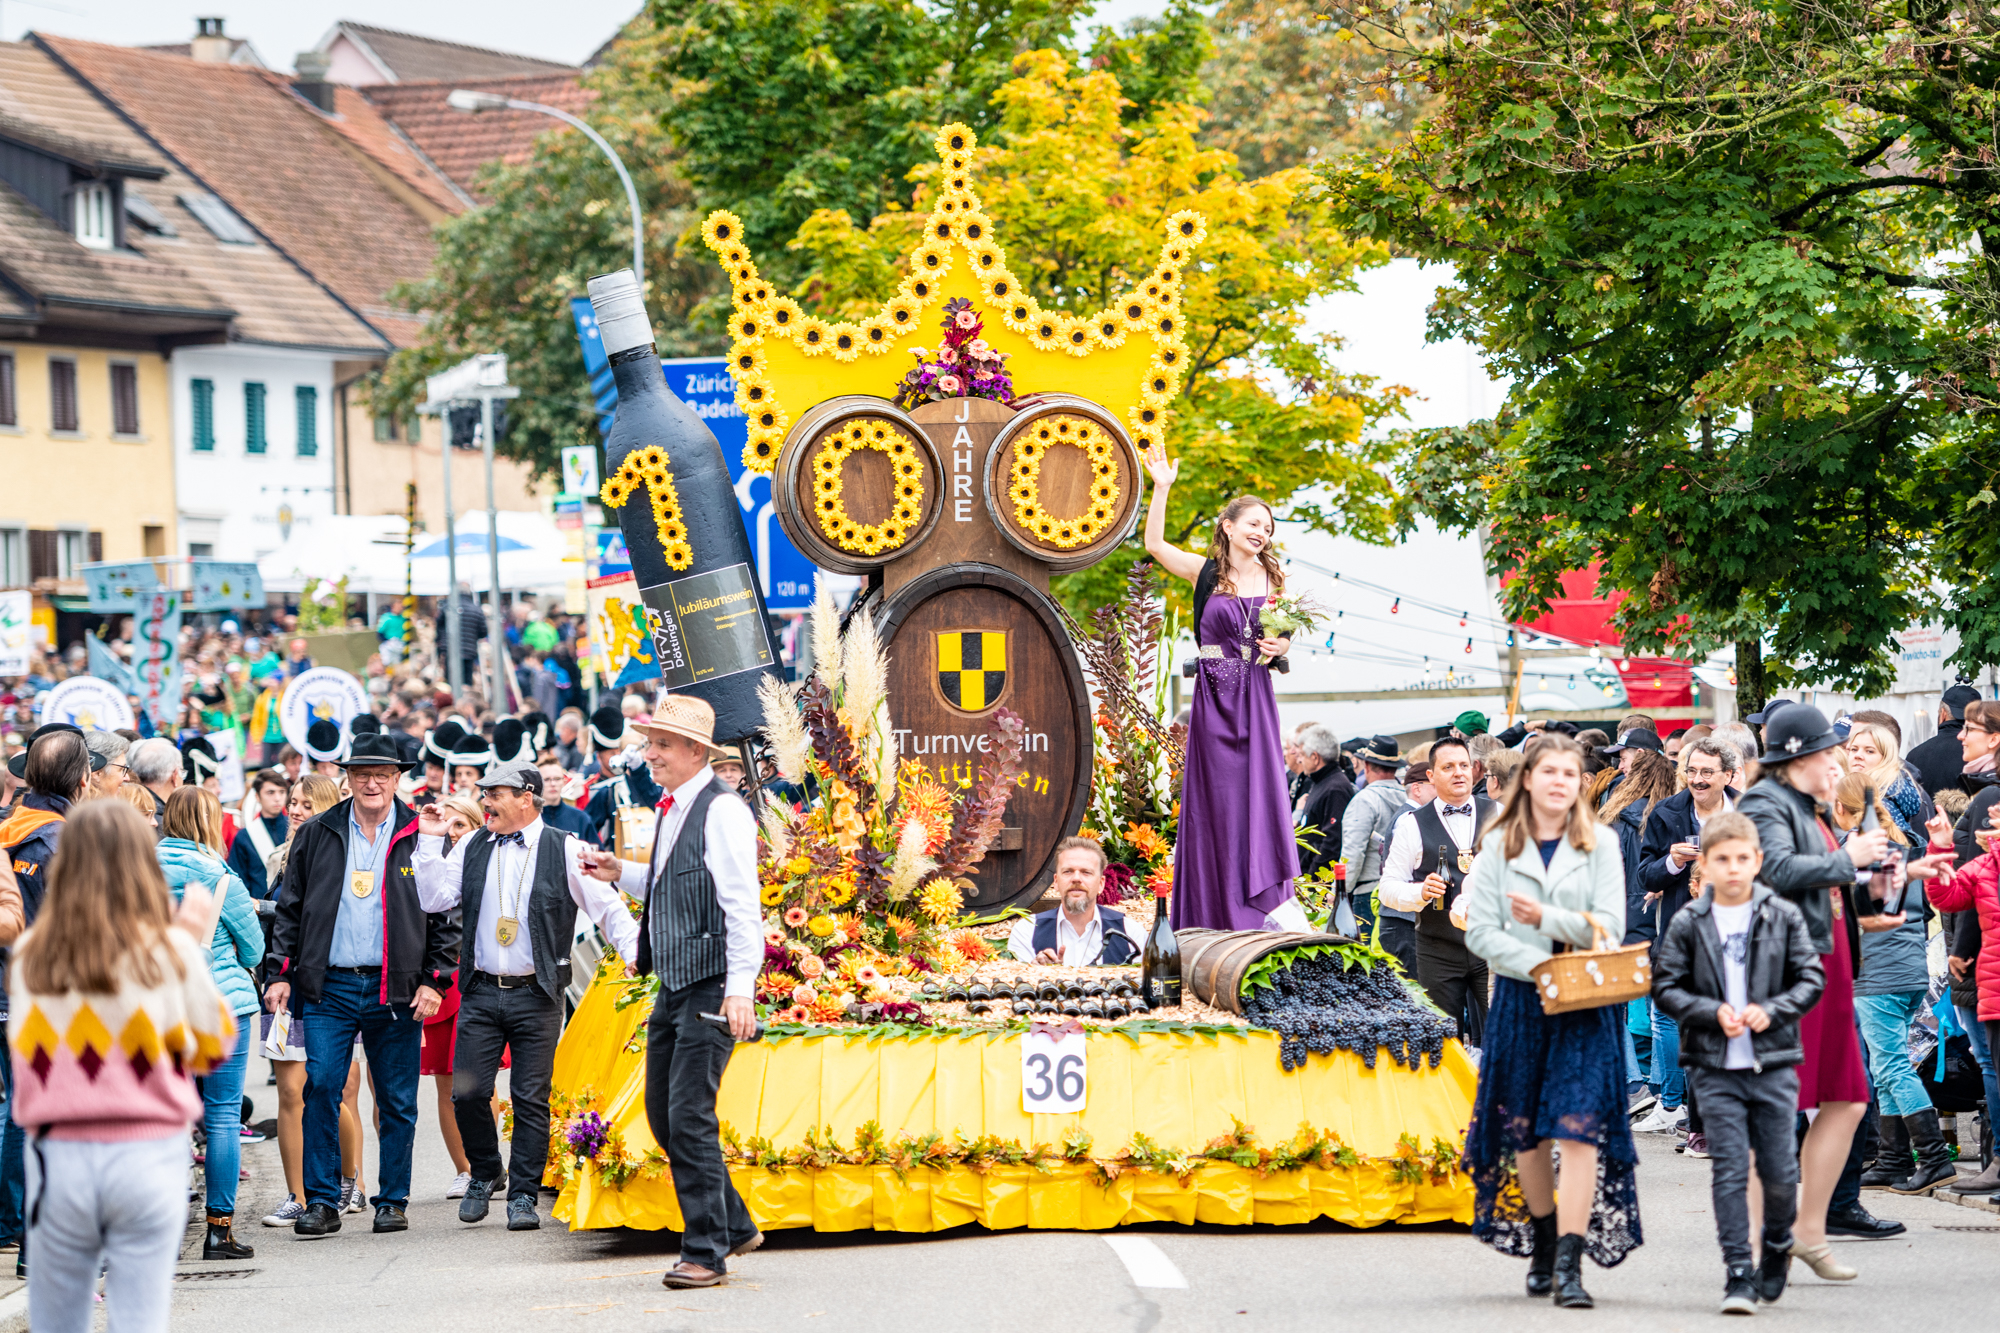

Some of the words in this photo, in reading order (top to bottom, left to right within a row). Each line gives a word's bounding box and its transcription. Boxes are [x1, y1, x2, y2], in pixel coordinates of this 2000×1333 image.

[685, 372, 738, 394] Zürich
[685, 397, 743, 419] Baden
[951, 400, 974, 522] JAHRE
[678, 588, 753, 616] Jubiläumswein
[777, 581, 796, 597] 120
[798, 583, 810, 596] m
[664, 610, 684, 668] Döttingen
[892, 727, 1049, 755] Turnvein
[1025, 1053, 1085, 1102] 36
